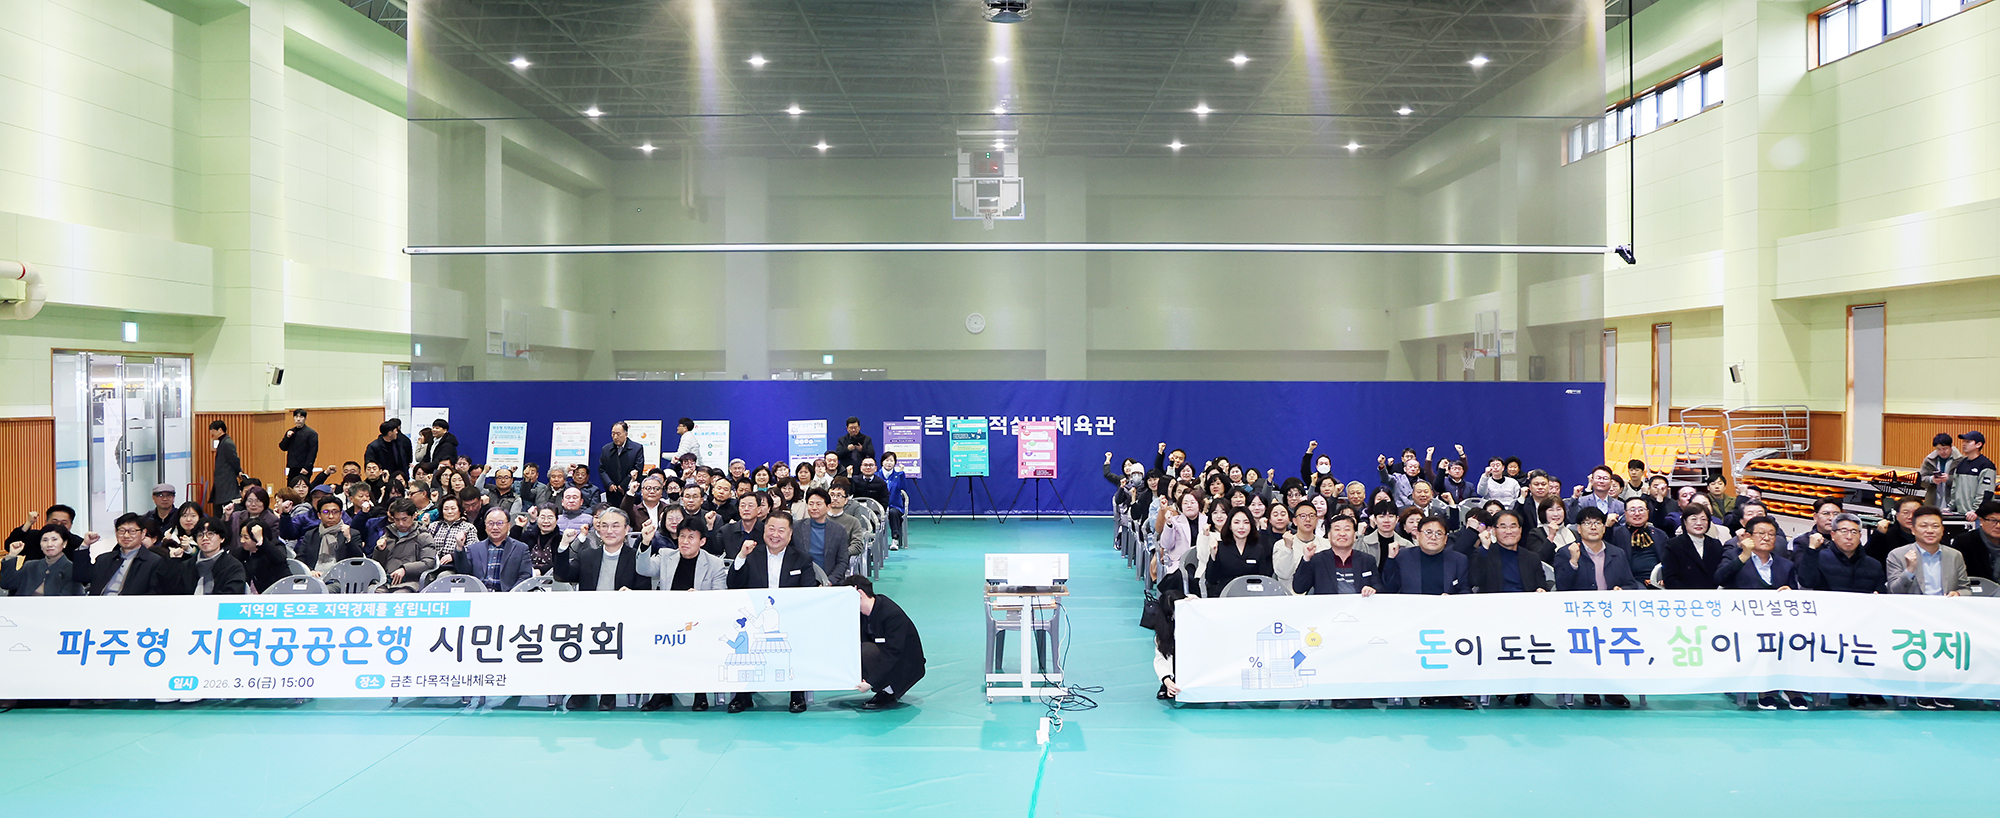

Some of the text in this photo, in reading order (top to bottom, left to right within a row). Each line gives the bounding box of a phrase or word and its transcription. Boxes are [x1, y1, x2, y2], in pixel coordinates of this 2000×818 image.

[903, 415, 1116, 436] 촌적체육관
[239, 602, 450, 618] 지역의 돈으로 지역경제를 살립니다!
[1564, 599, 1818, 618] 파주형 지역공공은행 시민설명회
[1274, 622, 1284, 634] B
[56, 621, 624, 668] 파주형 지역공공은행 시민설명회
[654, 634, 687, 647] PAJU
[1415, 625, 1971, 671] 돈이 도는 파주, 삶이 피어나는 경제
[172, 677, 194, 689] 일시
[203, 677, 315, 690] 2026. 3. 6(금) 15:00
[359, 675, 380, 688] 장소
[390, 674, 507, 688] 금촌 다목적실내체육관
